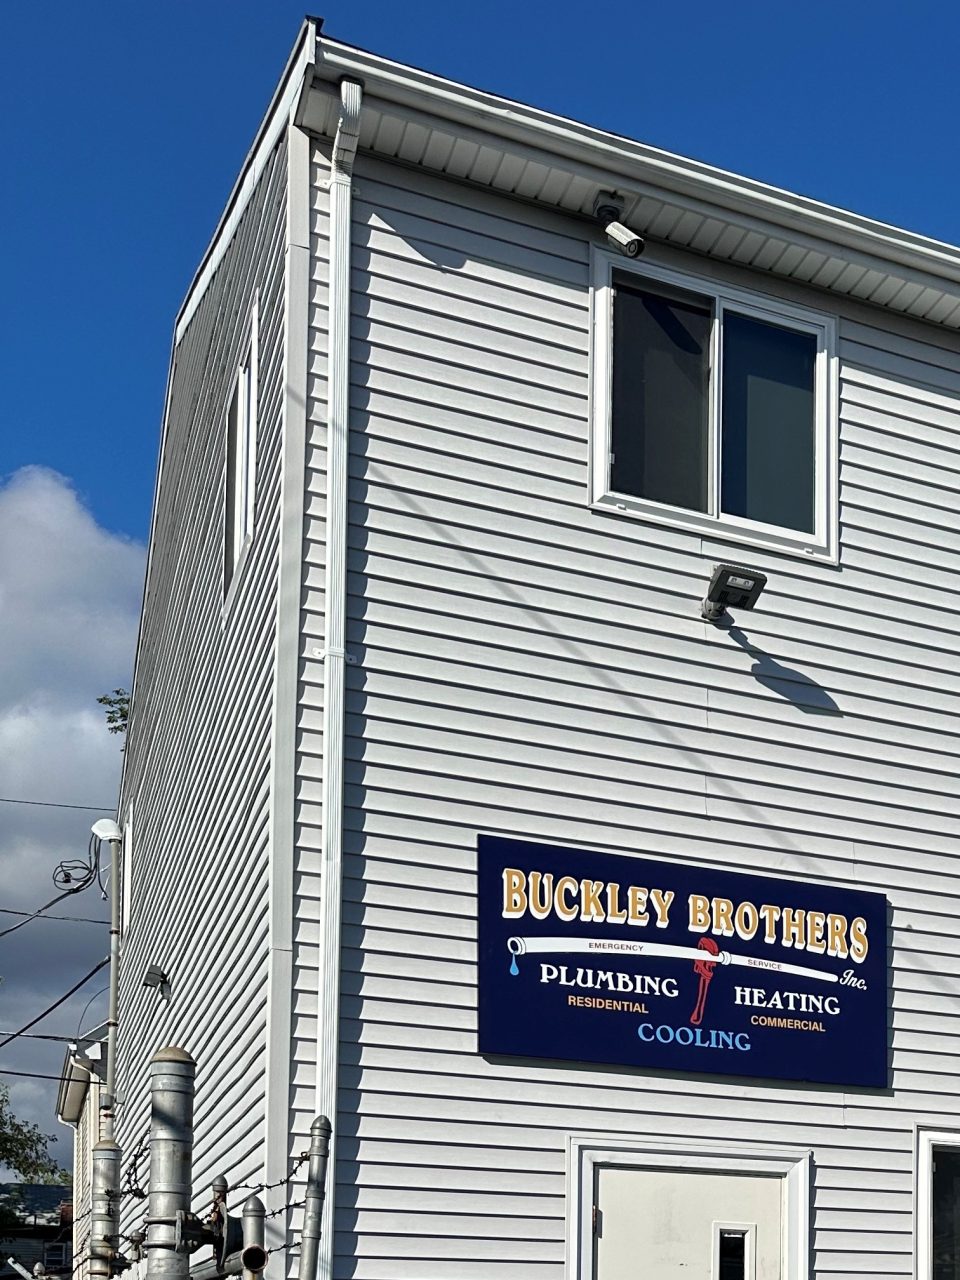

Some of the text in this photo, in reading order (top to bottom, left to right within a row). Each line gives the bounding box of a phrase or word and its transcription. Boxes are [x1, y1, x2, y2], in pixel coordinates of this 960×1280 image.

[502, 868, 869, 964] BUCKLEY BROTHERS
[588, 942, 783, 970] EMERGENCY SERVICE
[540, 963, 679, 998] PLUMBING
[839, 969, 868, 990] Inc.
[567, 995, 649, 1014] RESIDENTIAL
[734, 986, 841, 1015] HEATING
[637, 1023, 751, 1051] COOLING
[750, 1015, 826, 1032] COMMERCIAL
